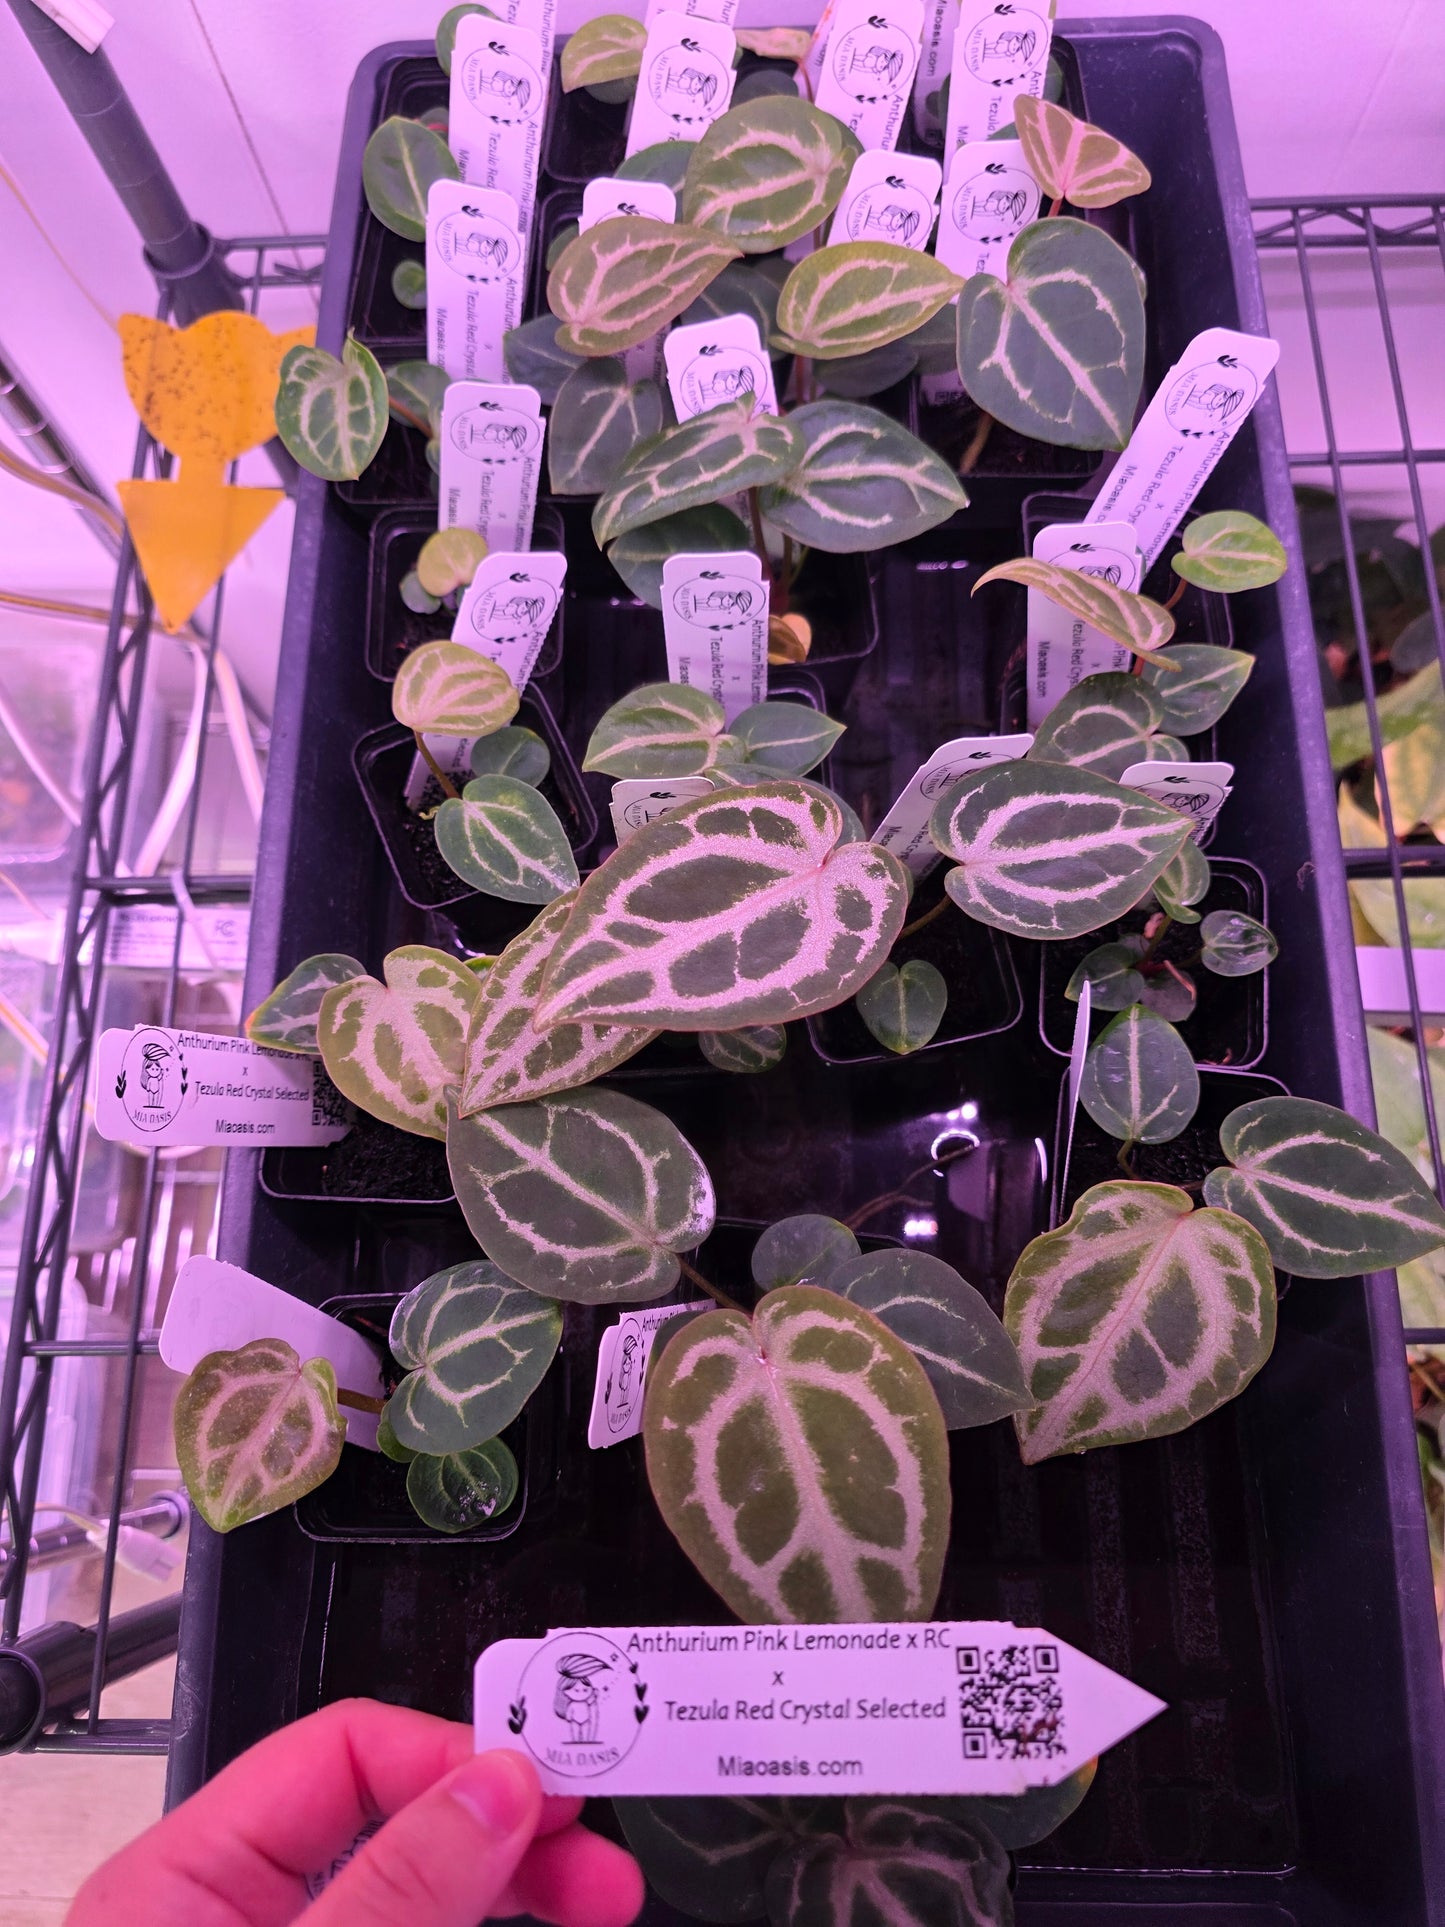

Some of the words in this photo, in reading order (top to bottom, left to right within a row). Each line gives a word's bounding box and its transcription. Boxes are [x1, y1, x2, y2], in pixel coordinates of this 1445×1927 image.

[541, 0, 554, 48] thurium
[1155, 445, 1184, 481] Tezula
[1187, 432, 1230, 492] Anthurium
[1141, 481, 1161, 503] Red
[1170, 492, 1193, 515] Pink
[177, 1033, 230, 1052] Anthurium
[231, 1037, 250, 1054] Pink
[242, 1066, 248, 1076] x
[195, 1081, 225, 1097] Tezula
[226, 1084, 243, 1097] Red
[245, 1085, 275, 1101] Crystal
[275, 1087, 310, 1101] Selected
[132, 1109, 148, 1124] MIA
[215, 1119, 276, 1134] Miaoasis.com
[627, 1632, 739, 1652] Anthurium
[743, 1629, 788, 1651] Pink
[793, 1628, 903, 1651] Lemonade
[905, 1635, 918, 1649] x
[923, 1628, 951, 1649] RC
[772, 1670, 784, 1686] x
[664, 1700, 729, 1721] Tezula
[734, 1699, 774, 1720] Red
[780, 1698, 850, 1726] Crystal
[856, 1698, 946, 1720] Selected
[546, 1748, 573, 1766] MIA
[717, 1755, 863, 1777] Miaoasis.com
